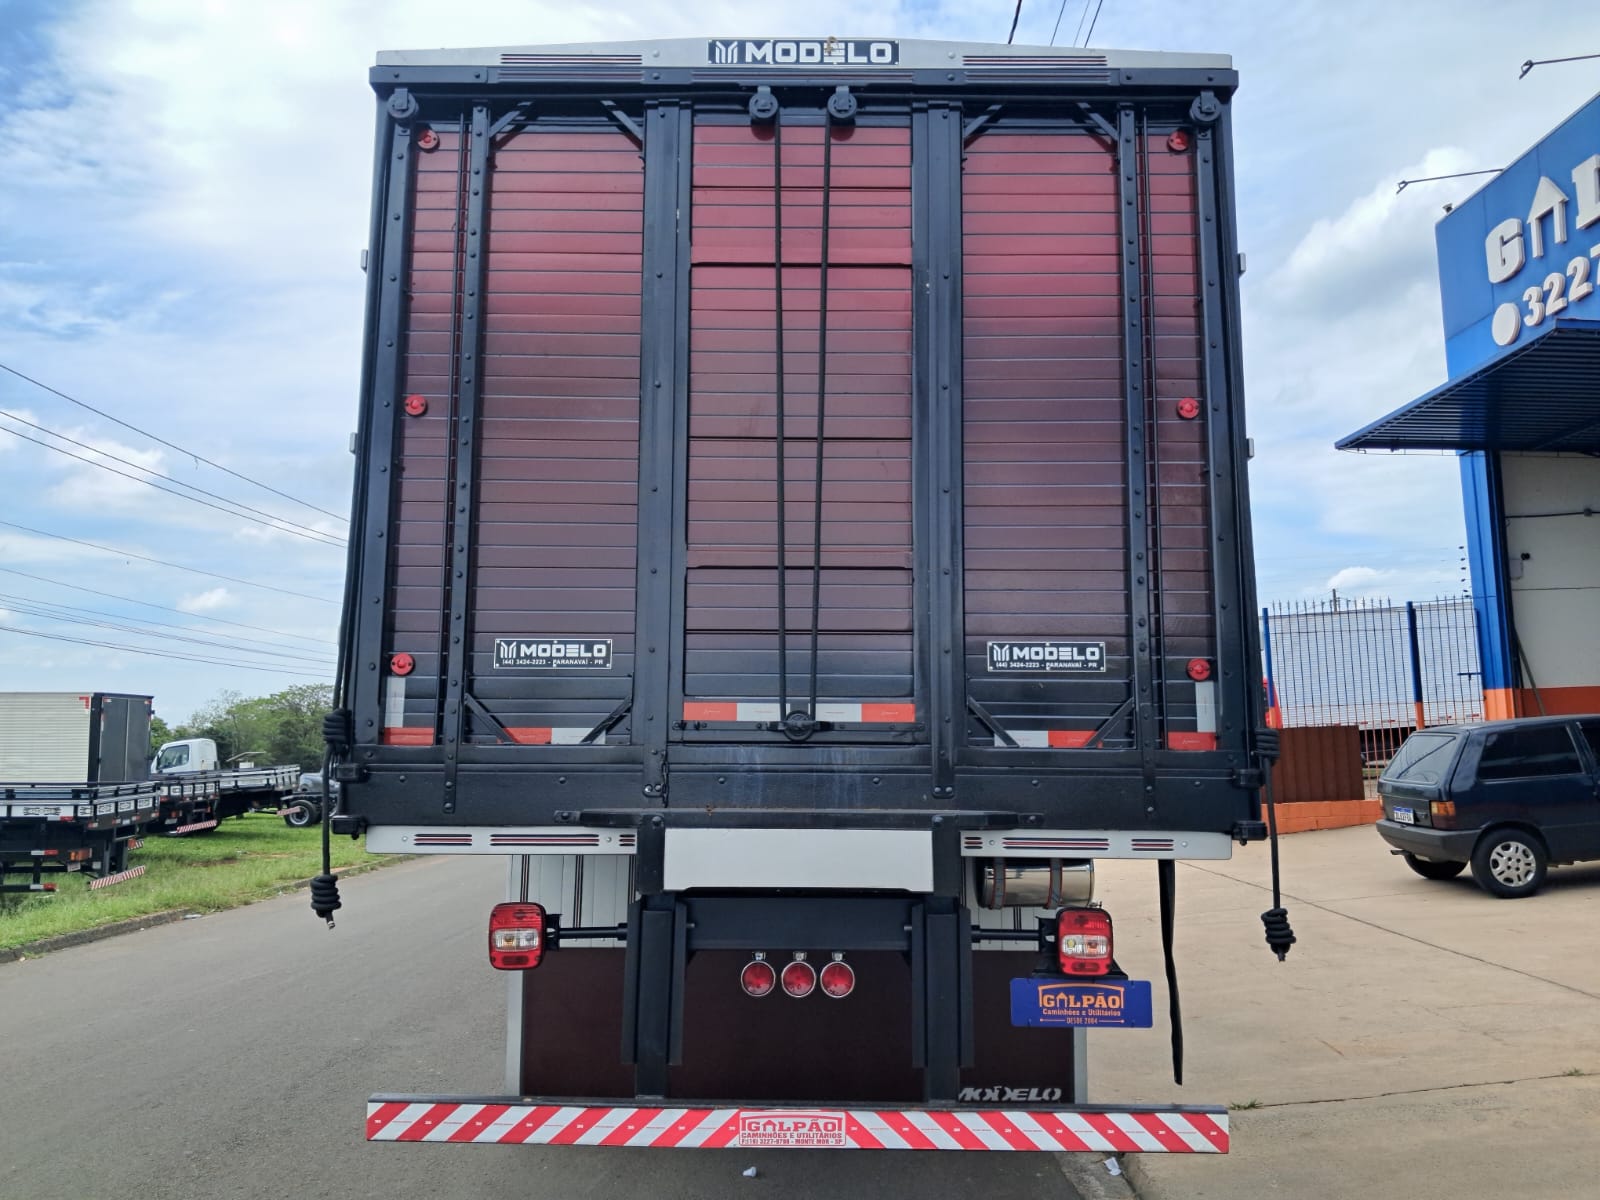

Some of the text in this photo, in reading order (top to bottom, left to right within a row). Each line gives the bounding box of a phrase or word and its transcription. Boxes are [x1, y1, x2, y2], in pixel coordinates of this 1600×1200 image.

[745, 42, 892, 63] MODELO
[520, 644, 607, 657] MODELO
[1013, 647, 1100, 660] MODELO
[1042, 992, 1121, 1009] GALPÃO
[747, 1119, 837, 1132] GALPÃO
